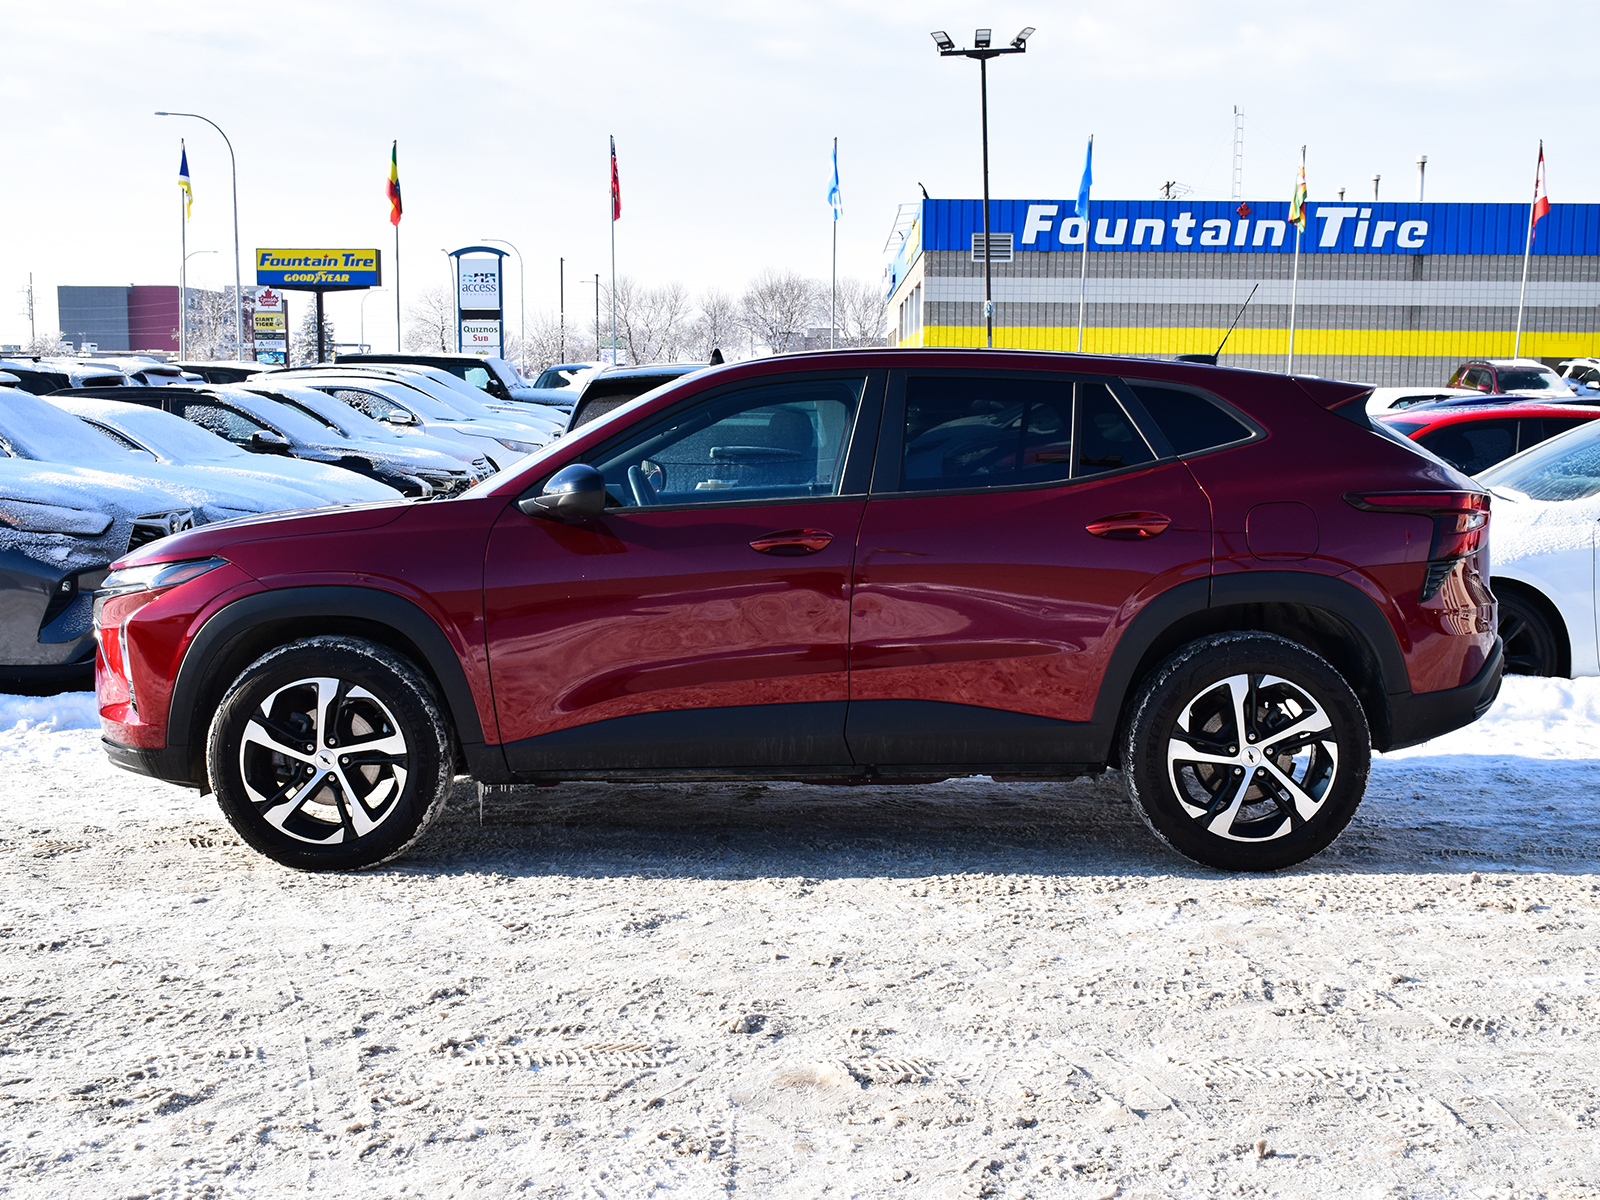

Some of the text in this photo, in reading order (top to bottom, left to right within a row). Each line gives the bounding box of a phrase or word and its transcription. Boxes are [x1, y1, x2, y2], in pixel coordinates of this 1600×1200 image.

[1021, 203, 1428, 248] Fountain Tire
[259, 253, 374, 266] Fountain Tire
[284, 272, 349, 283] GOODYEAR
[462, 284, 496, 292] access
